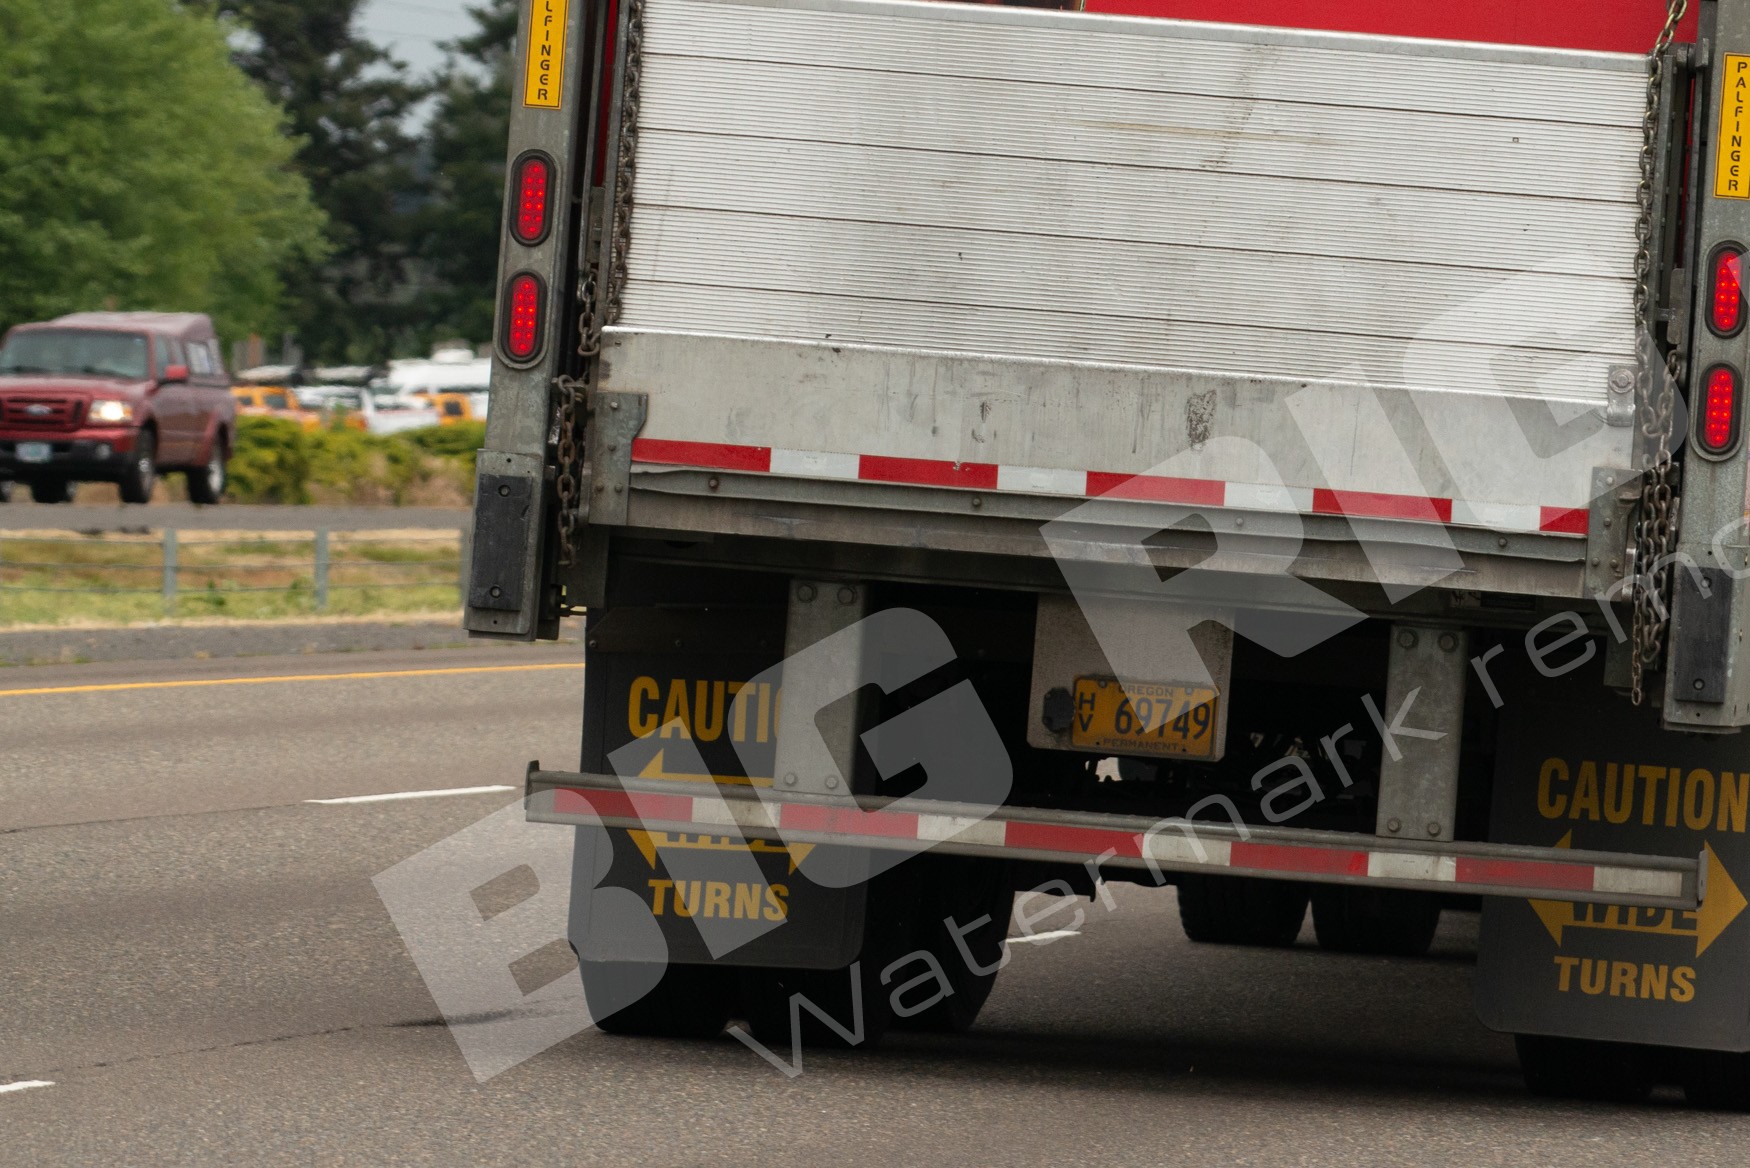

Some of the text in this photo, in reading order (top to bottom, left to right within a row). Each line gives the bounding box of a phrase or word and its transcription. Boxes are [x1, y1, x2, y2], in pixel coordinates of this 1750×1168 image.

[1728, 61, 1748, 192] PALFINGER
[628, 675, 784, 743] CAUTI
[1119, 685, 1174, 697] OREGON
[1114, 698, 1211, 740] 69749
[1102, 737, 1178, 751] PERMANENT
[1537, 756, 1750, 833] CAUTION
[648, 878, 790, 922] TURNS
[1553, 955, 1697, 1003] TURNS
